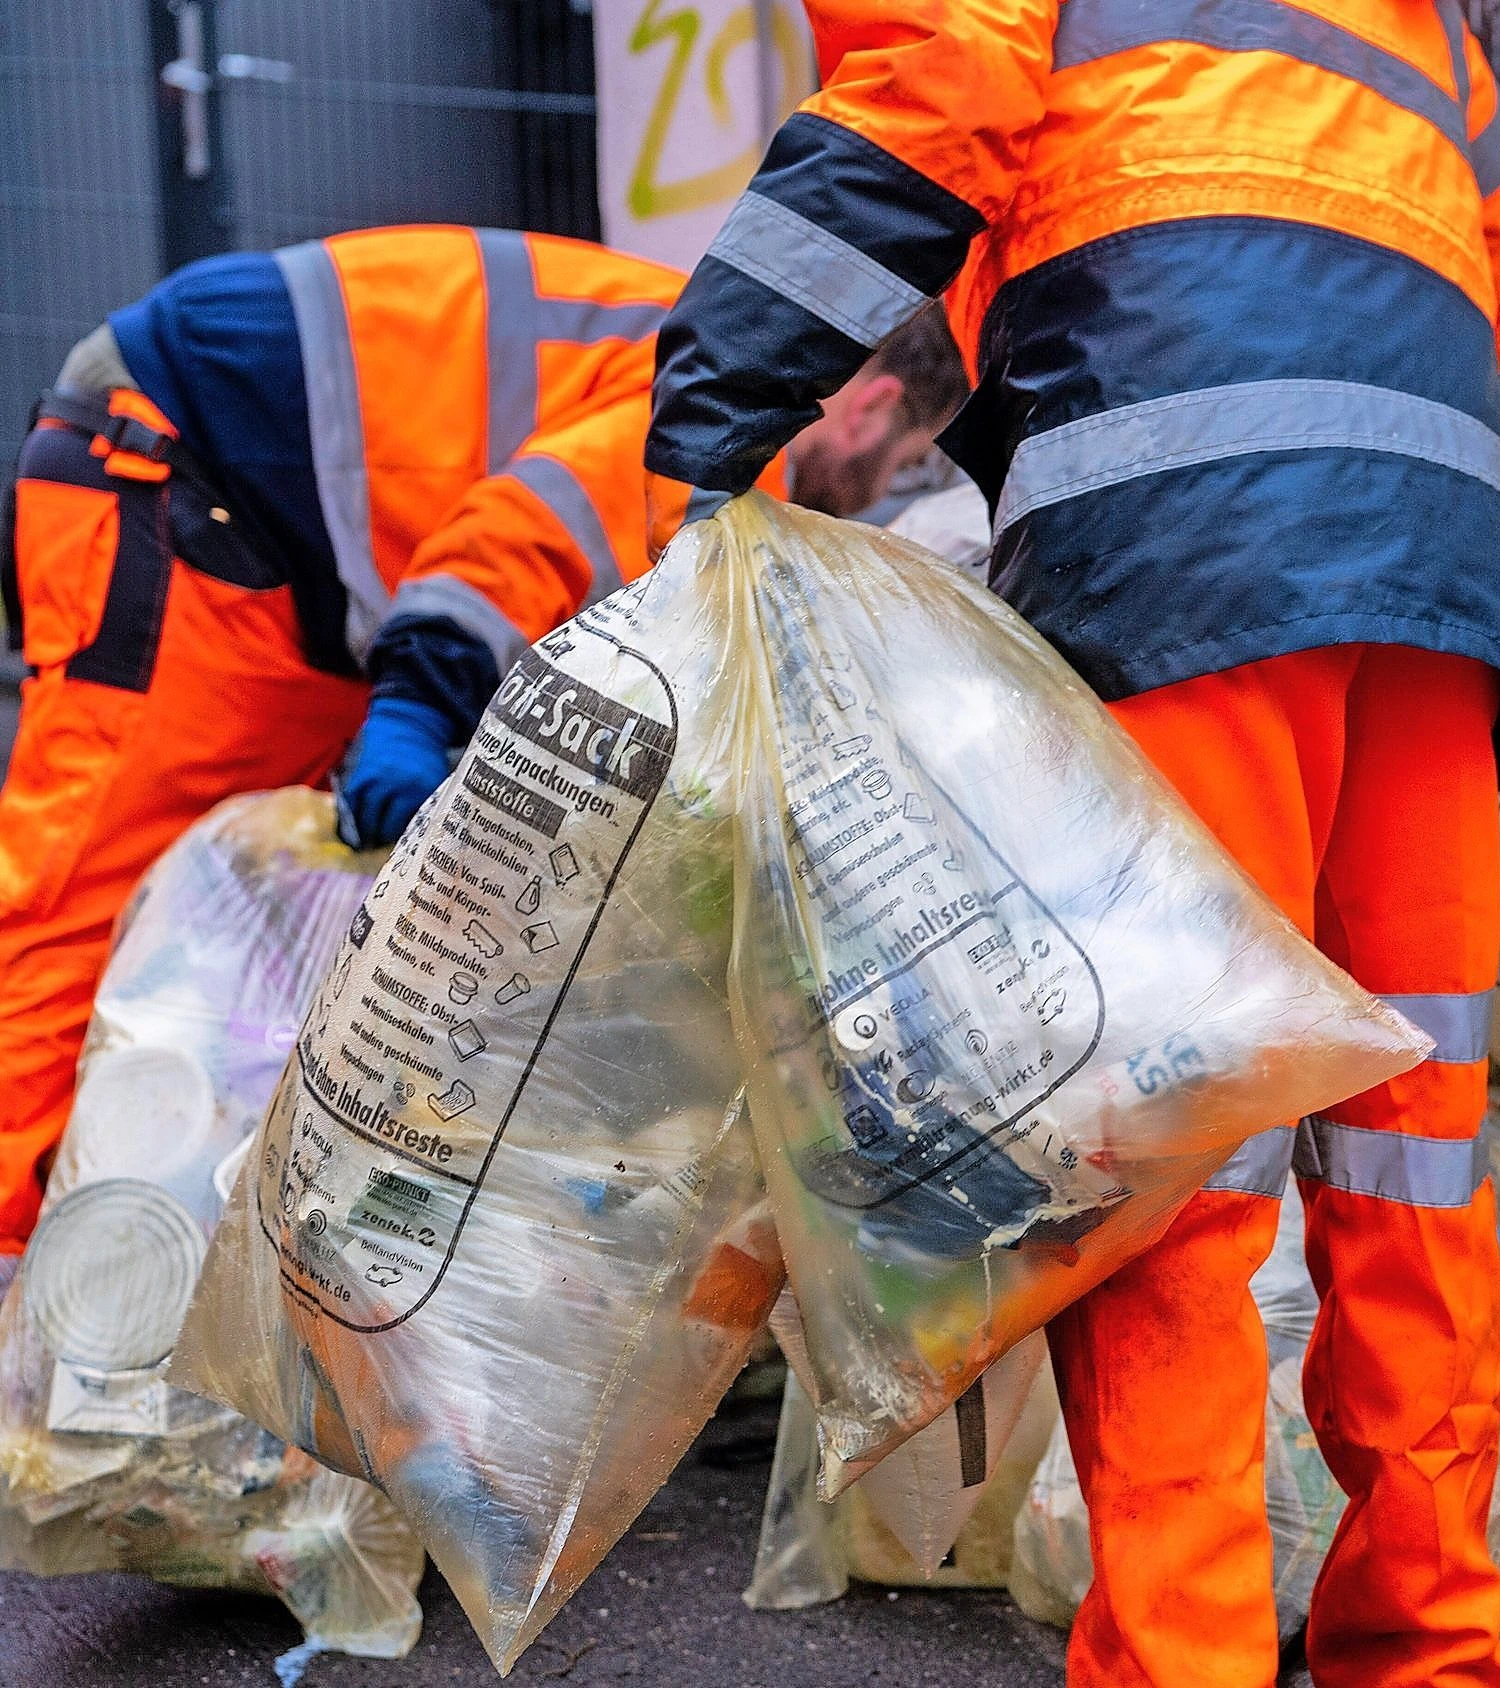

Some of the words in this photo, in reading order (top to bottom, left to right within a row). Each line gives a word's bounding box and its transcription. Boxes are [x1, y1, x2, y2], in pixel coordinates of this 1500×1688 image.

[436, 881, 456, 898] und
[455, 888, 492, 919] Körper-
[460, 863, 479, 888] Von
[480, 877, 506, 901] Spül-
[874, 888, 994, 966] Inhaltsre
[417, 930, 489, 980] Milchprodukte,
[430, 1002, 460, 1026] Obst-
[383, 1044, 444, 1082] geschäumte
[335, 1080, 453, 1163] Inhaltsreste
